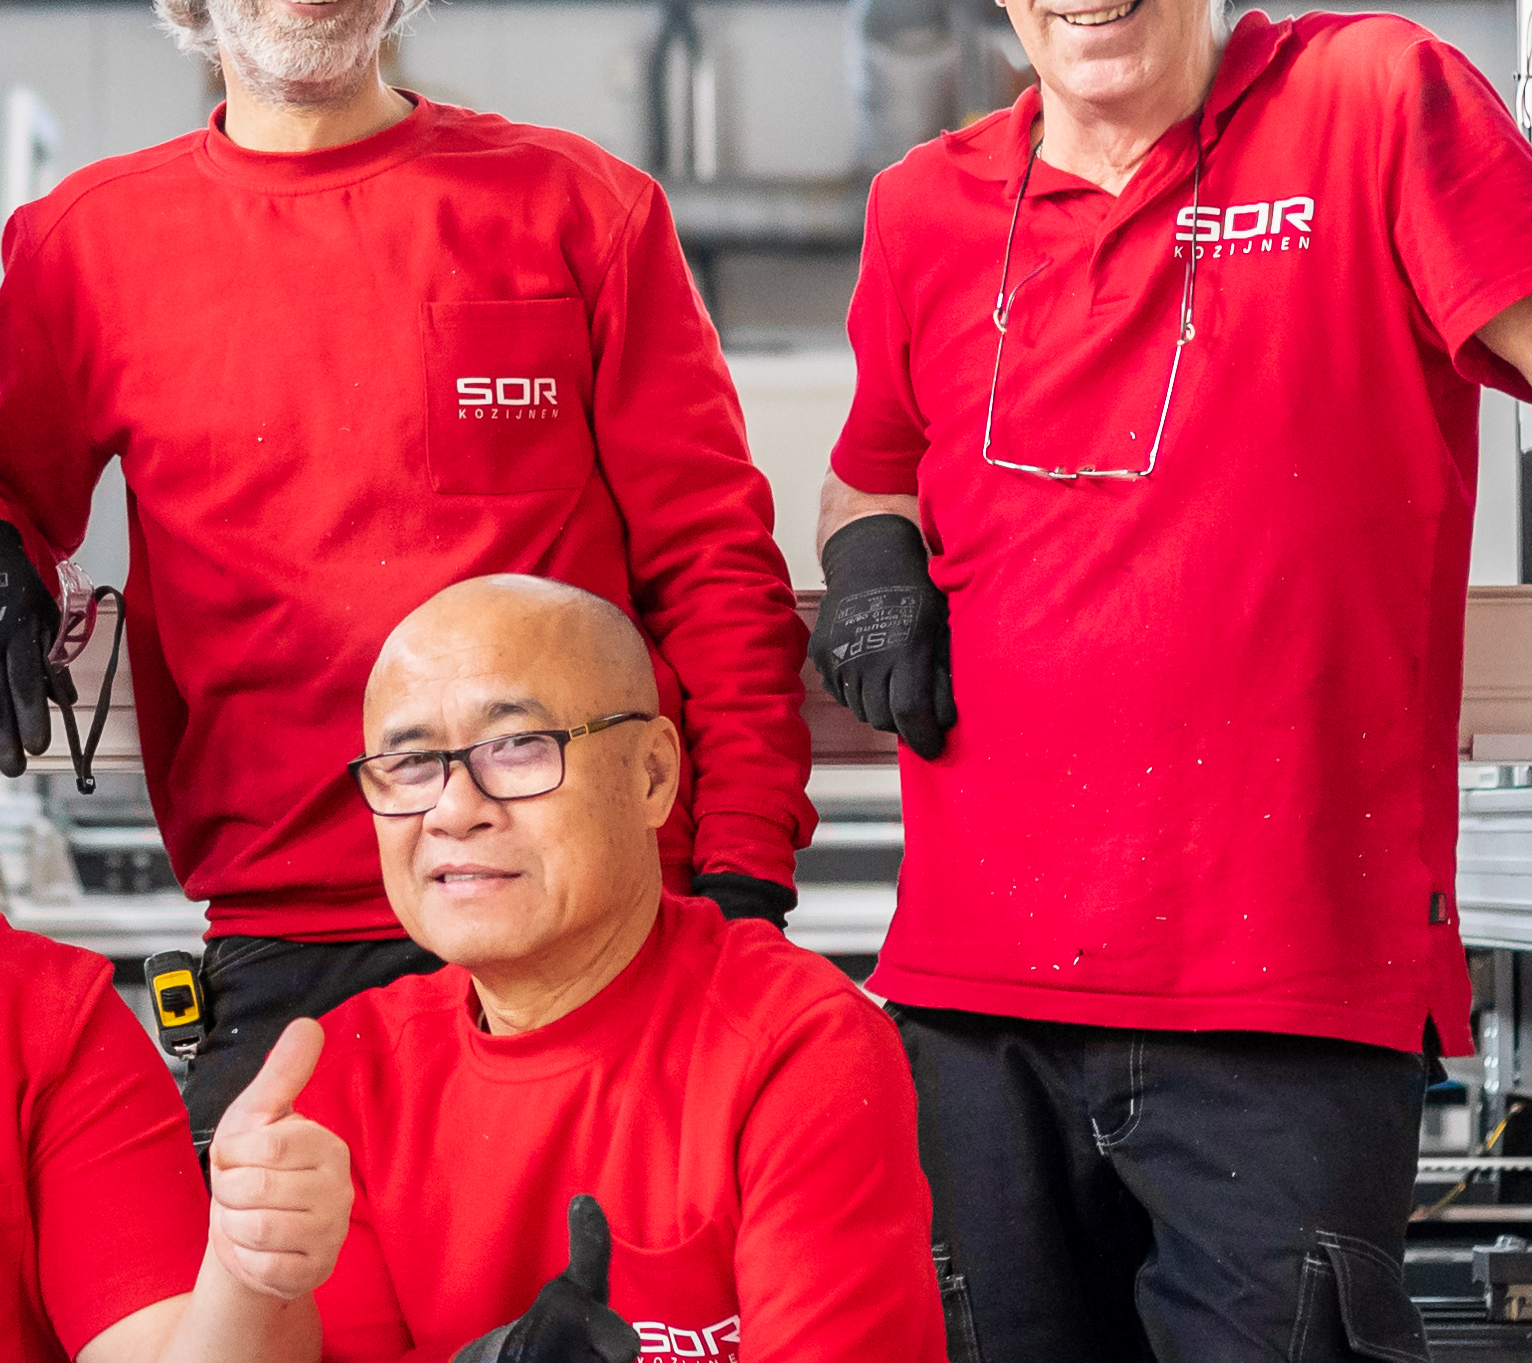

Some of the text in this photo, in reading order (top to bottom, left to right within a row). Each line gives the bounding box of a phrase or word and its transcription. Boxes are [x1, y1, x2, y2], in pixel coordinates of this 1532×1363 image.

[1175, 196, 1315, 242] SOR
[1173, 236, 1310, 260] KOZIJNEN
[456, 377, 558, 406] SOR
[458, 408, 559, 420] KOZIJNEN
[632, 1314, 740, 1357] SOR
